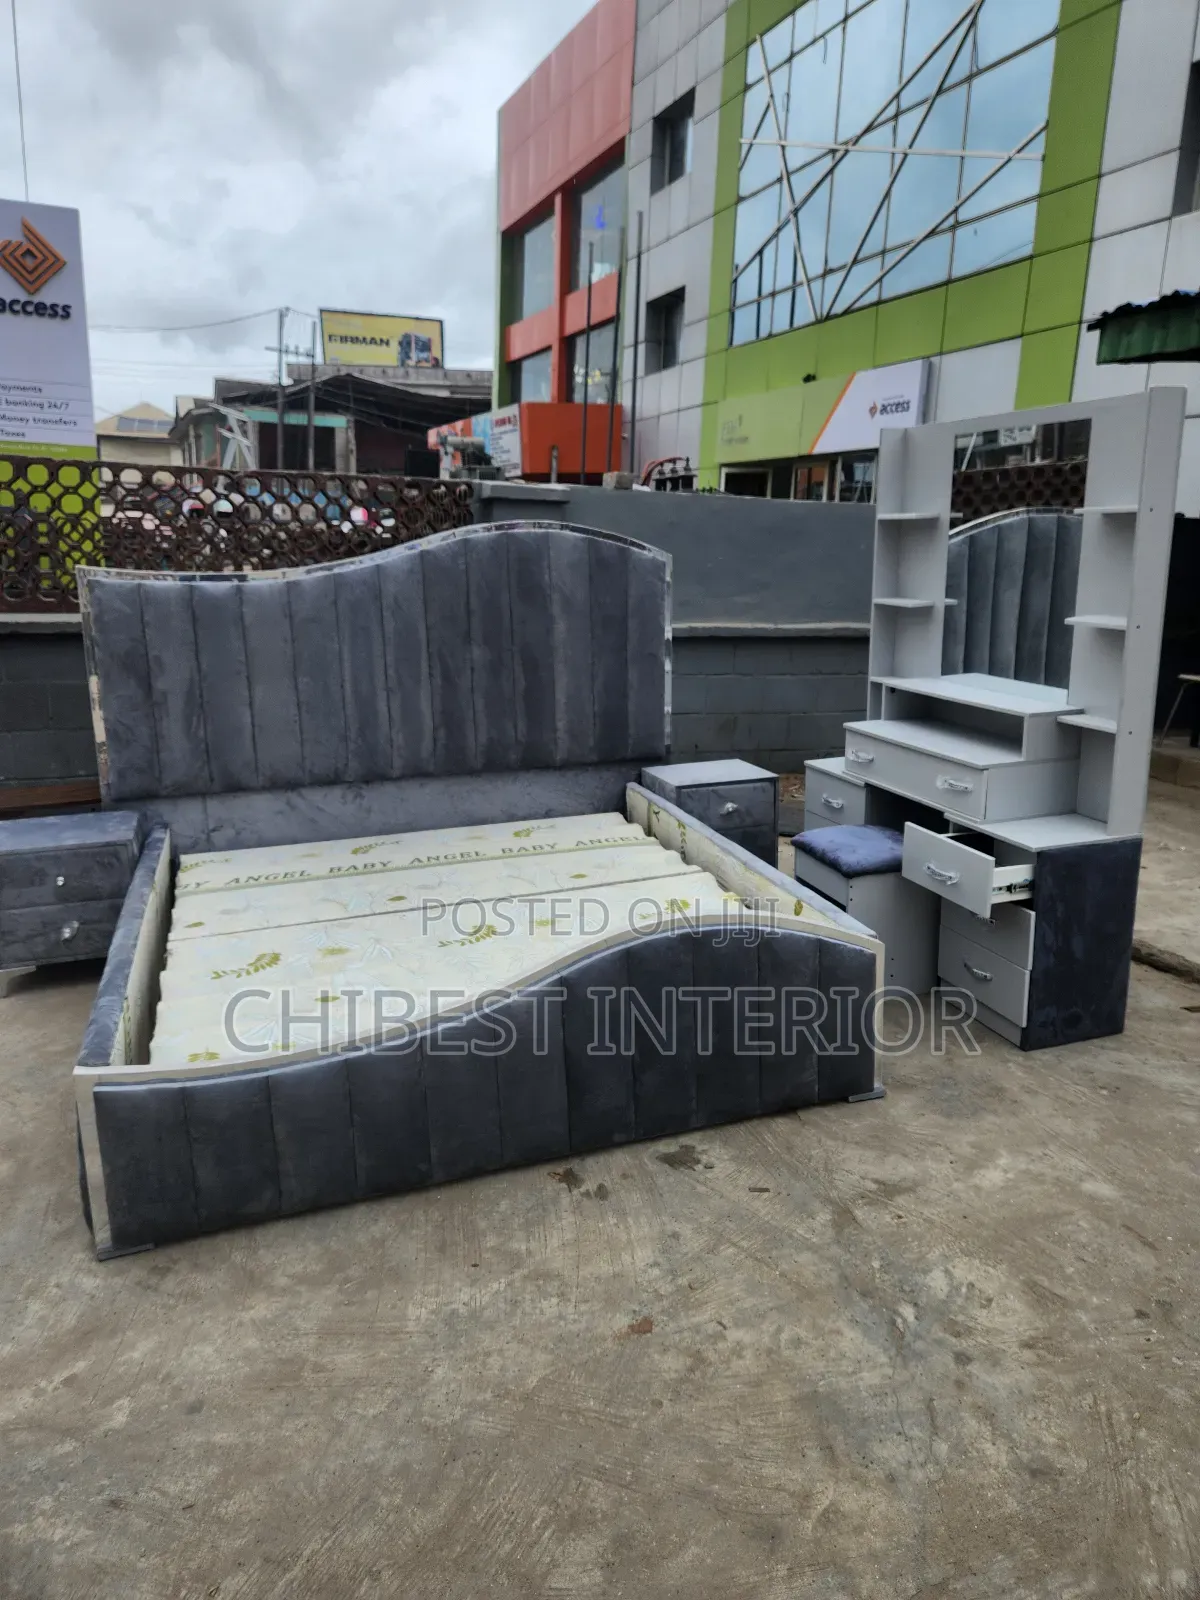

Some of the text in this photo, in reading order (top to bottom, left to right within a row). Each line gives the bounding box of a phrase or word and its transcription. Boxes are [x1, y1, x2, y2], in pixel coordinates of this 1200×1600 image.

[328, 334, 391, 348] FIRMAN
[880, 400, 911, 415] access
[225, 870, 311, 886] ANGEL
[329, 860, 392, 874] BABY
[409, 850, 486, 865] ANGEL
[501, 843, 558, 854] BABY
[575, 836, 645, 847] ANGEL
